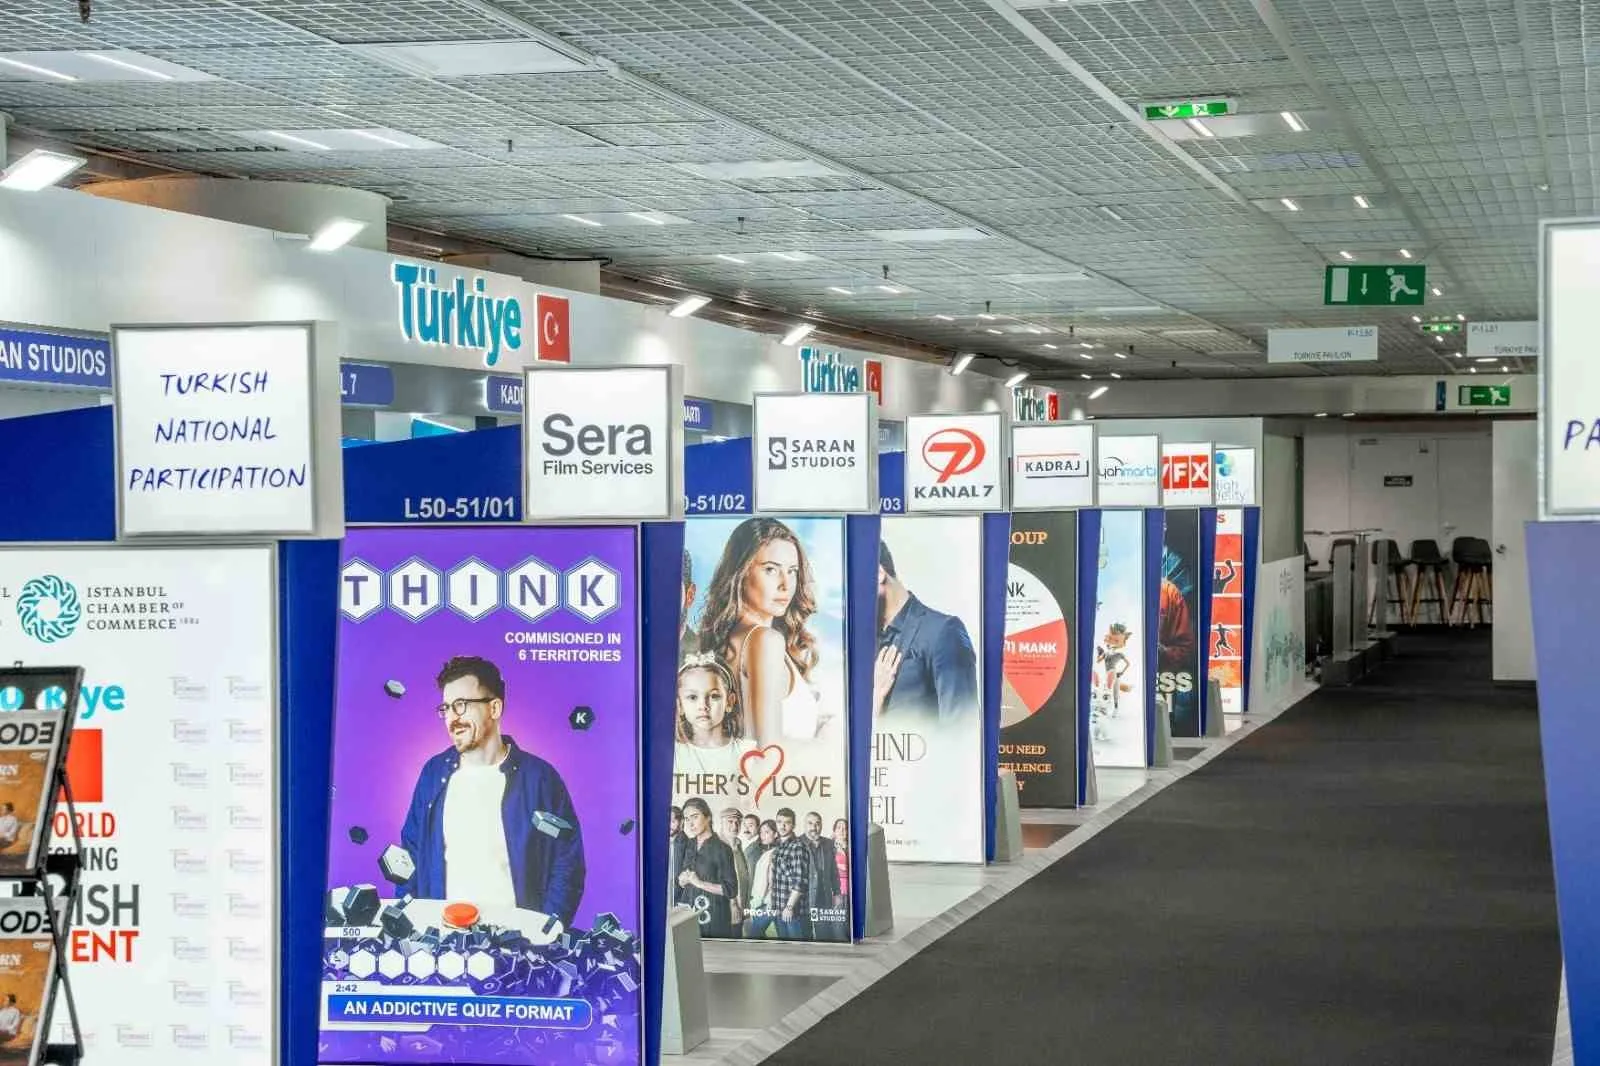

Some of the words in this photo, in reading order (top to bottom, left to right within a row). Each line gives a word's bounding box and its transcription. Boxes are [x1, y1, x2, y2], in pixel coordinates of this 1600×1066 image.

[393, 262, 522, 367] Türkiye
[28, 344, 105, 377] STUDIOS
[160, 370, 268, 395] TURKISH
[350, 373, 358, 394] 7
[155, 417, 277, 443] NATIONAL
[543, 413, 652, 457] Sera
[791, 440, 855, 453] SARAN
[543, 461, 578, 476] Film
[581, 461, 654, 476] Services
[791, 456, 855, 468] STUDIOS
[1025, 460, 1081, 472] KADRAJ
[129, 463, 306, 491] PARTICIPATION
[914, 486, 980, 499] KANAL
[983, 485, 995, 498] 7
[404, 497, 515, 519] L50-51/01
[1009, 531, 1048, 545] OUP
[87, 586, 168, 598] ISTANBUL
[344, 574, 605, 606] THINK
[86, 602, 170, 614] CHAMBER
[86, 619, 177, 630] COMMERCE
[504, 632, 604, 645] COMMISIONED
[607, 633, 621, 645] IN
[518, 650, 526, 661] 6
[530, 650, 621, 662] TERRITORIES
[1156, 671, 1193, 693] SS
[1016, 744, 1046, 755] NEED
[772, 775, 833, 798] LOVE
[342, 927, 361, 937] 500
[335, 983, 358, 994] 2:42
[344, 1001, 367, 1015] AN
[371, 1001, 458, 1017] ADDICTIVE
[464, 1003, 501, 1018] QUIZ
[505, 1005, 574, 1021] FORMAT
